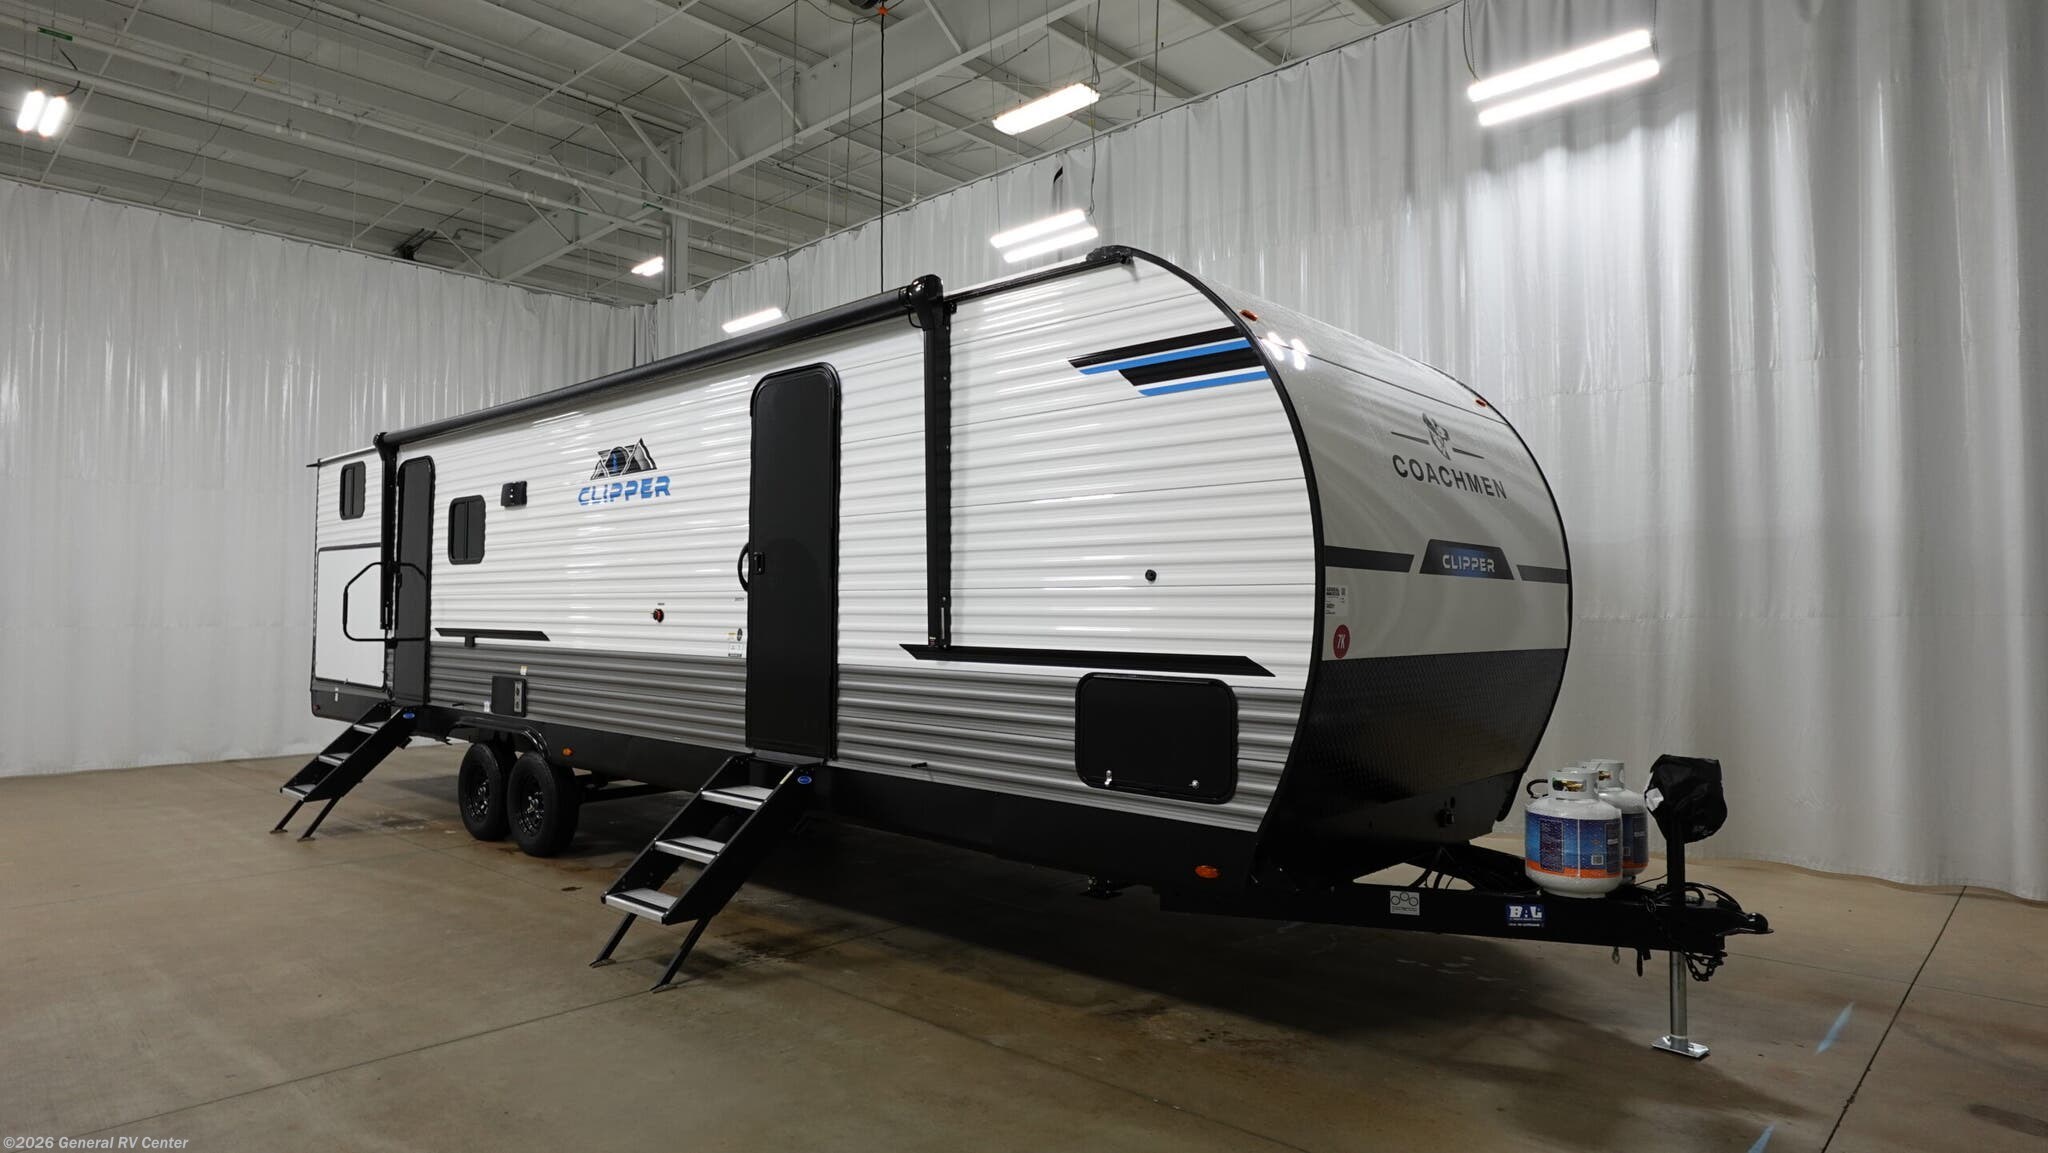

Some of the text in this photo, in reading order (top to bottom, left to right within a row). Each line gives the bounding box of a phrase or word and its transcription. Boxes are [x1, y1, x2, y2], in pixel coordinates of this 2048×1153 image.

[1392, 454, 1508, 500] COACHMEN
[578, 475, 671, 506] CLIPPER
[1442, 554, 1496, 573] CLIPPER
[1337, 633, 1345, 649] 7K
[1509, 905, 1543, 919] BAL
